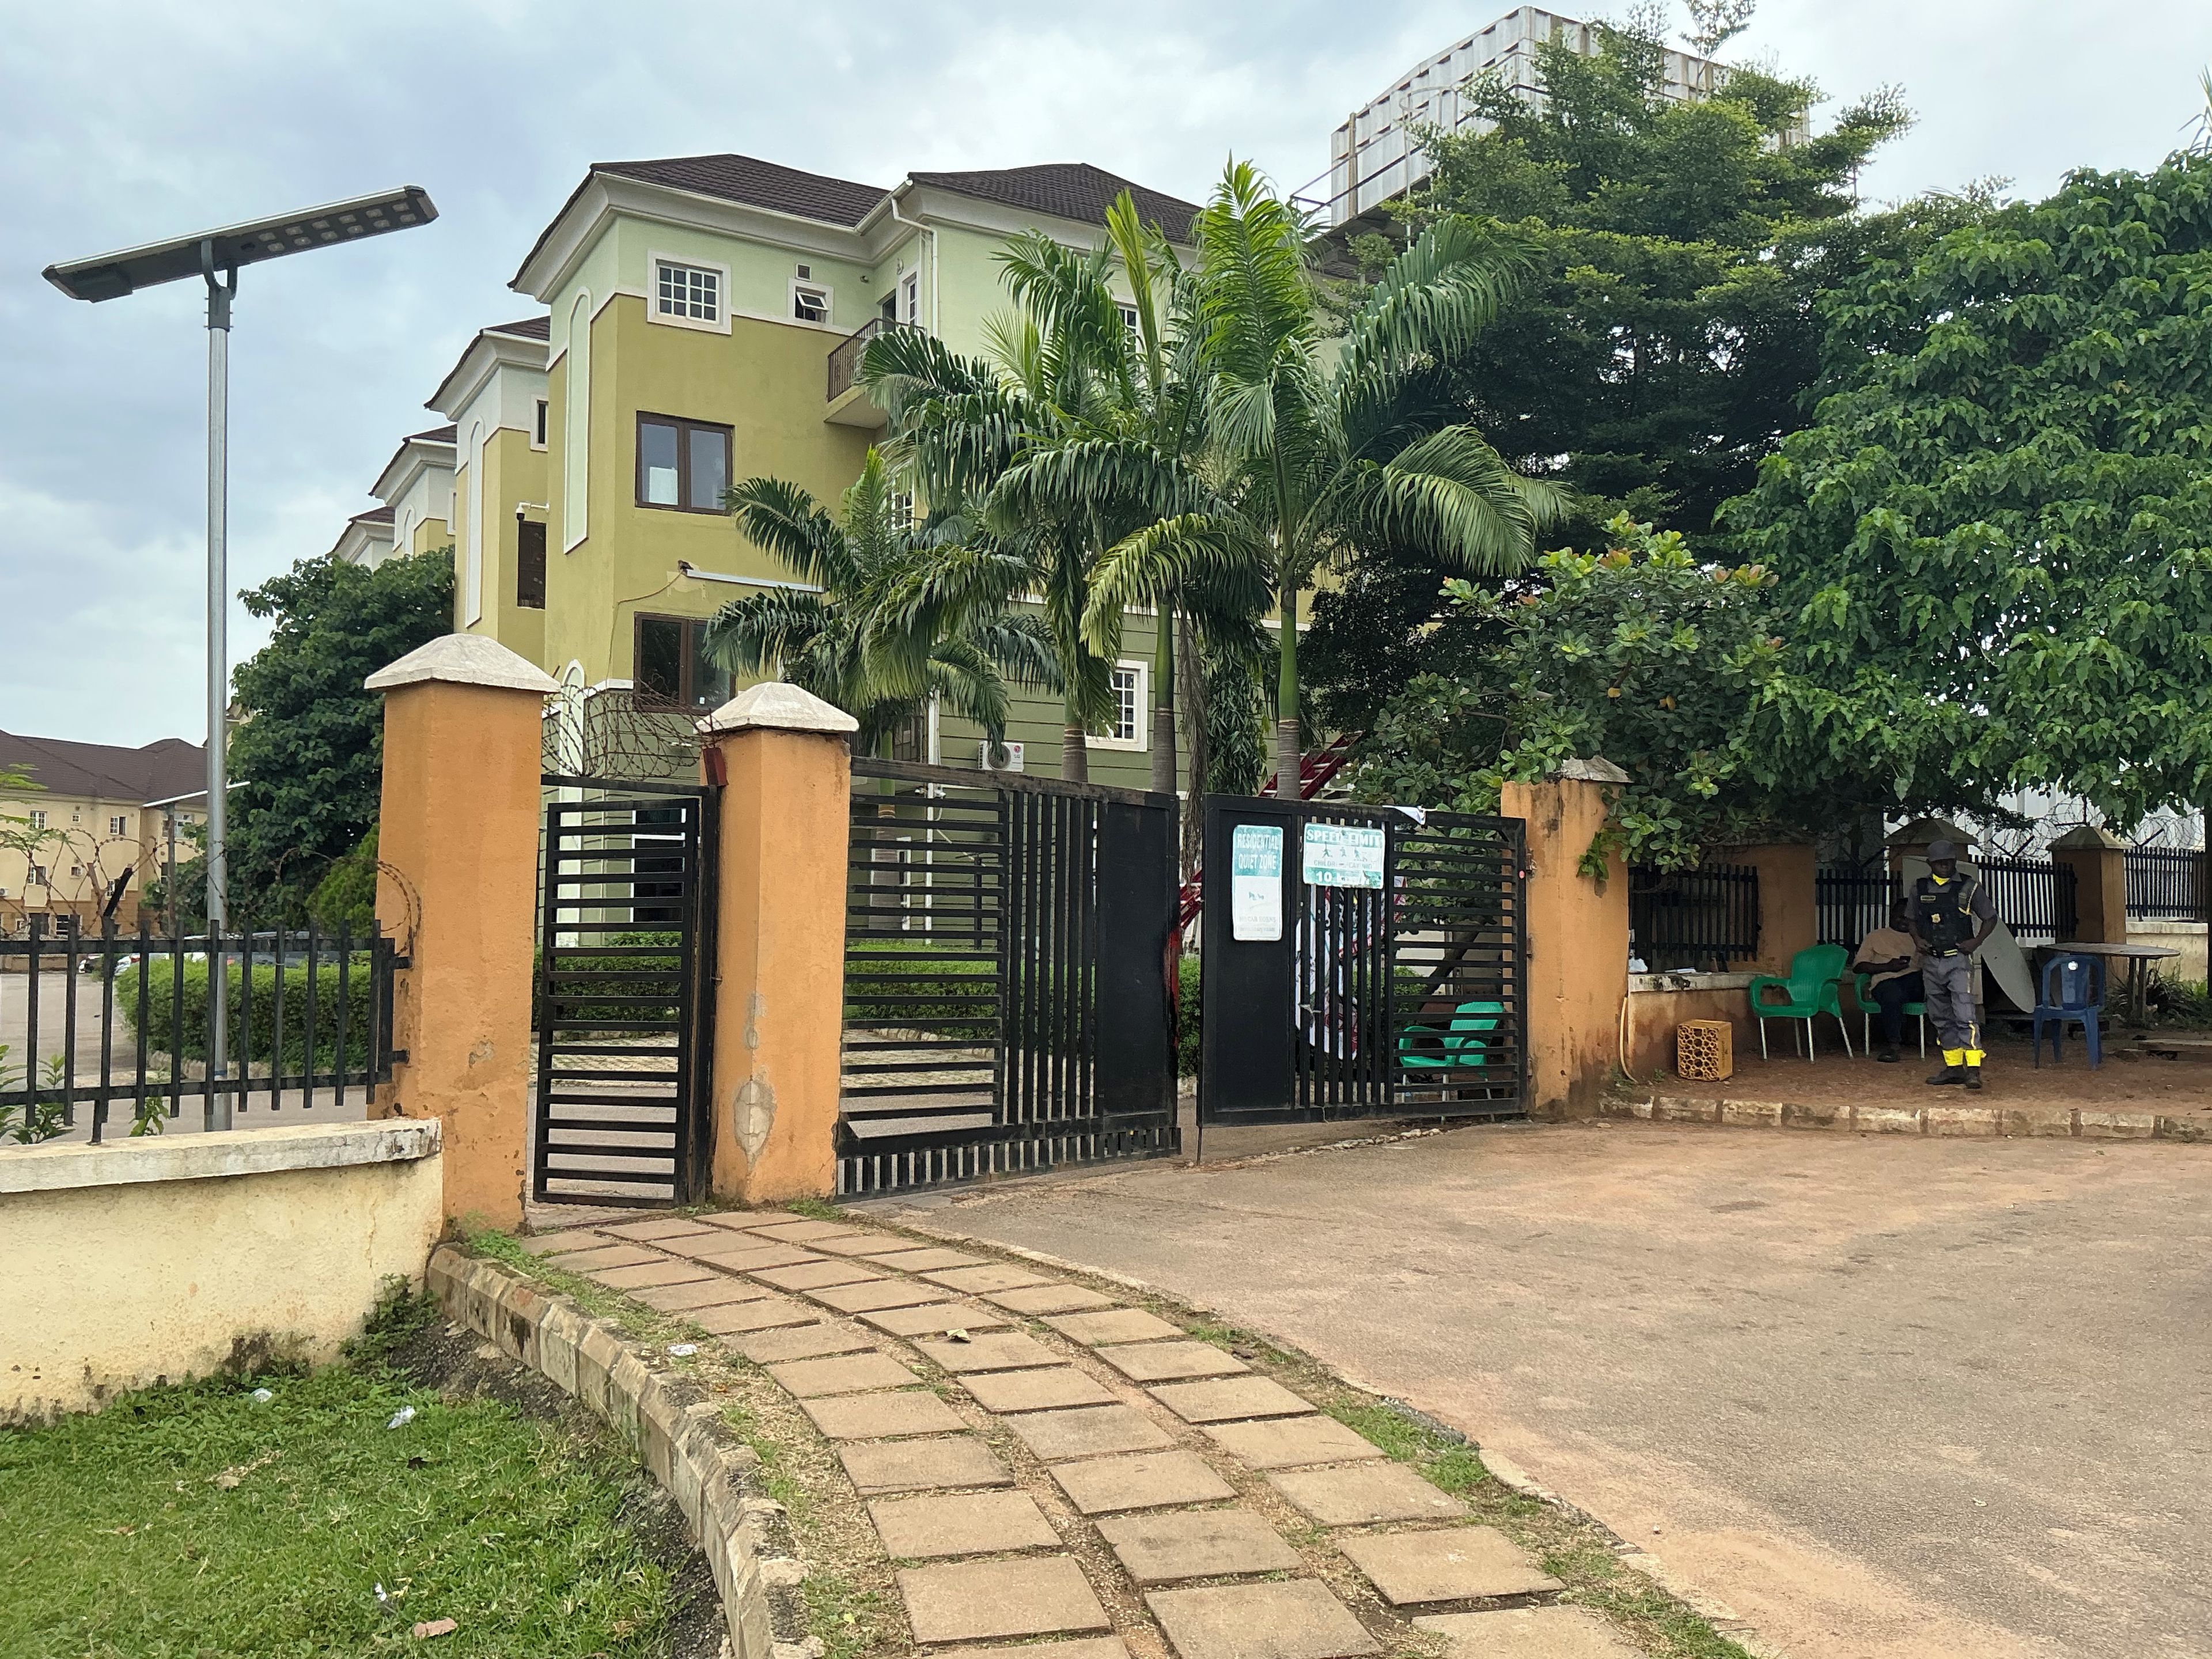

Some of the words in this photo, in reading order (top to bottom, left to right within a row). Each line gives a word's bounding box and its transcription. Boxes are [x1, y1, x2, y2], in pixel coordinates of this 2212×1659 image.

[1237, 833, 1278, 850] RESIDENTIAL
[1238, 853, 1258, 869] QUIET
[1259, 854, 1277, 870] ZONE
[1316, 870, 1332, 882] 10
